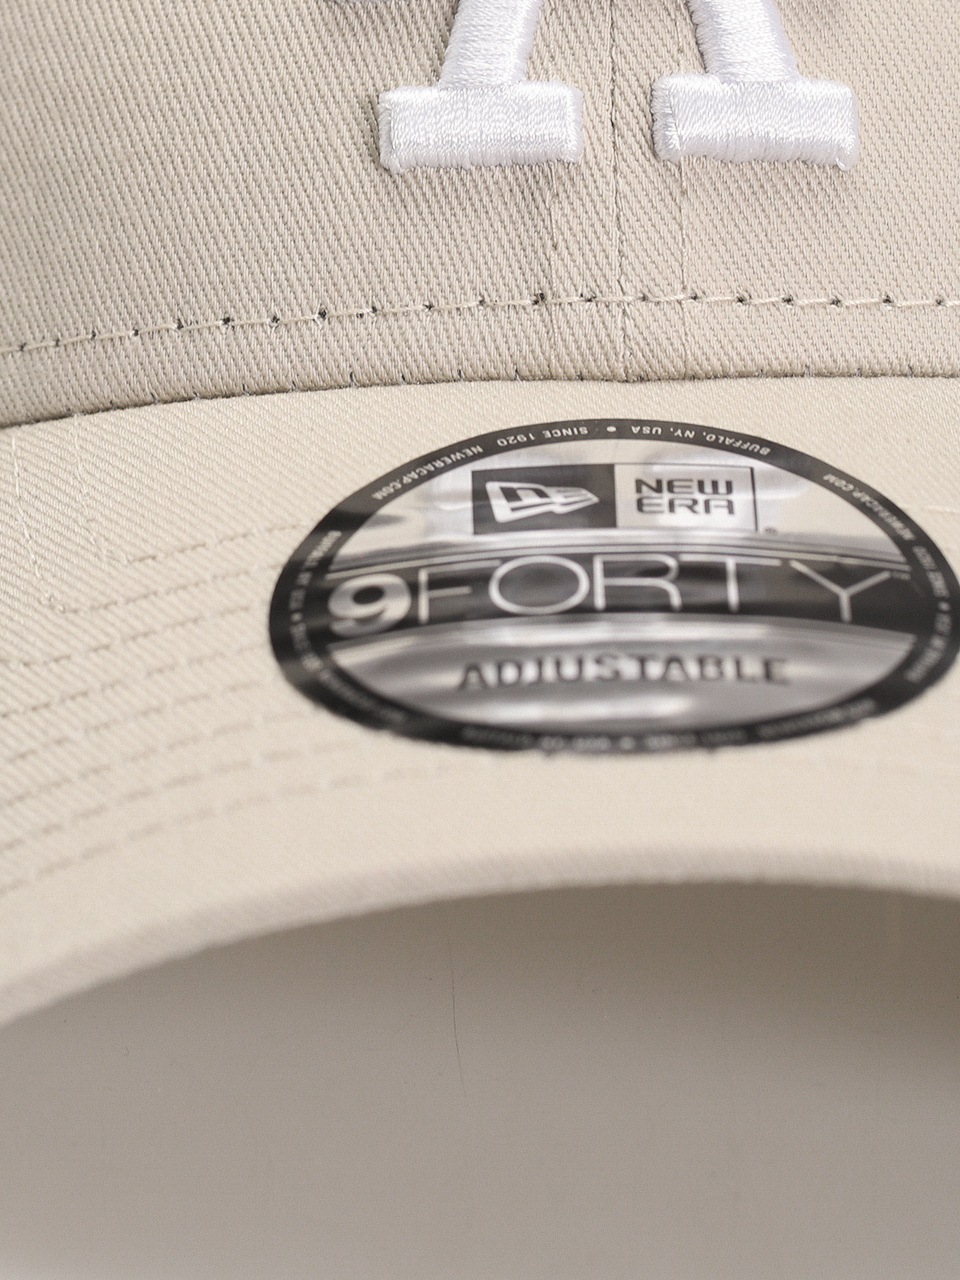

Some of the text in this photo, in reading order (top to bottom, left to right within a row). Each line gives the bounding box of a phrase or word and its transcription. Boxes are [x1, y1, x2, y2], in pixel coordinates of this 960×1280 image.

[496, 432, 536, 448] 1920
[542, 425, 589, 439] SINCE
[630, 425, 663, 436] USA
[702, 430, 772, 456] BUFFALO,
[371, 444, 484, 500] NEWERACAP.COM
[634, 478, 734, 496] NEW
[636, 496, 735, 515] ERA
[327, 553, 892, 637] 9FORTY
[456, 652, 790, 691] ADJUSTABLE
